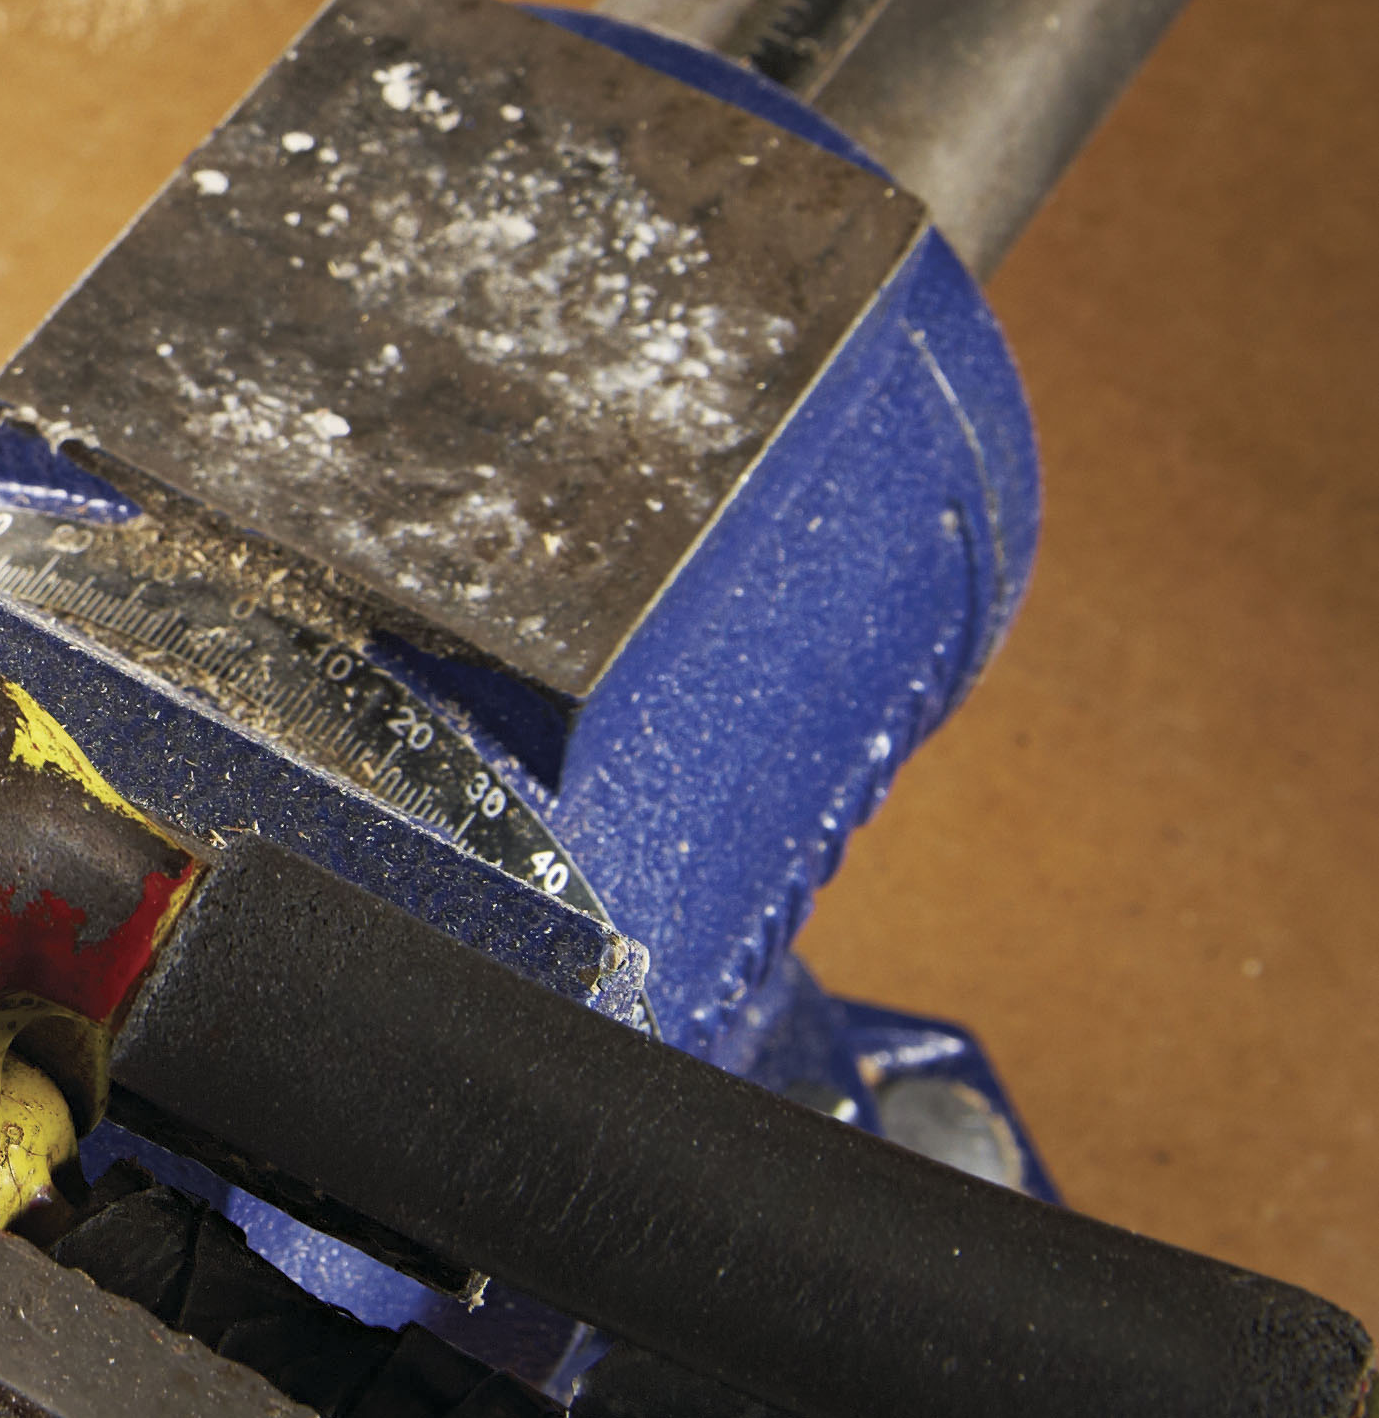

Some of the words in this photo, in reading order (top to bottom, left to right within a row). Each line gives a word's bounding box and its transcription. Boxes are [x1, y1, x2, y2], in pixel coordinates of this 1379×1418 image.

[312, 644, 353, 680] 10
[388, 706, 433, 750] 20
[465, 772, 506, 817] 30
[530, 851, 569, 894] 40
